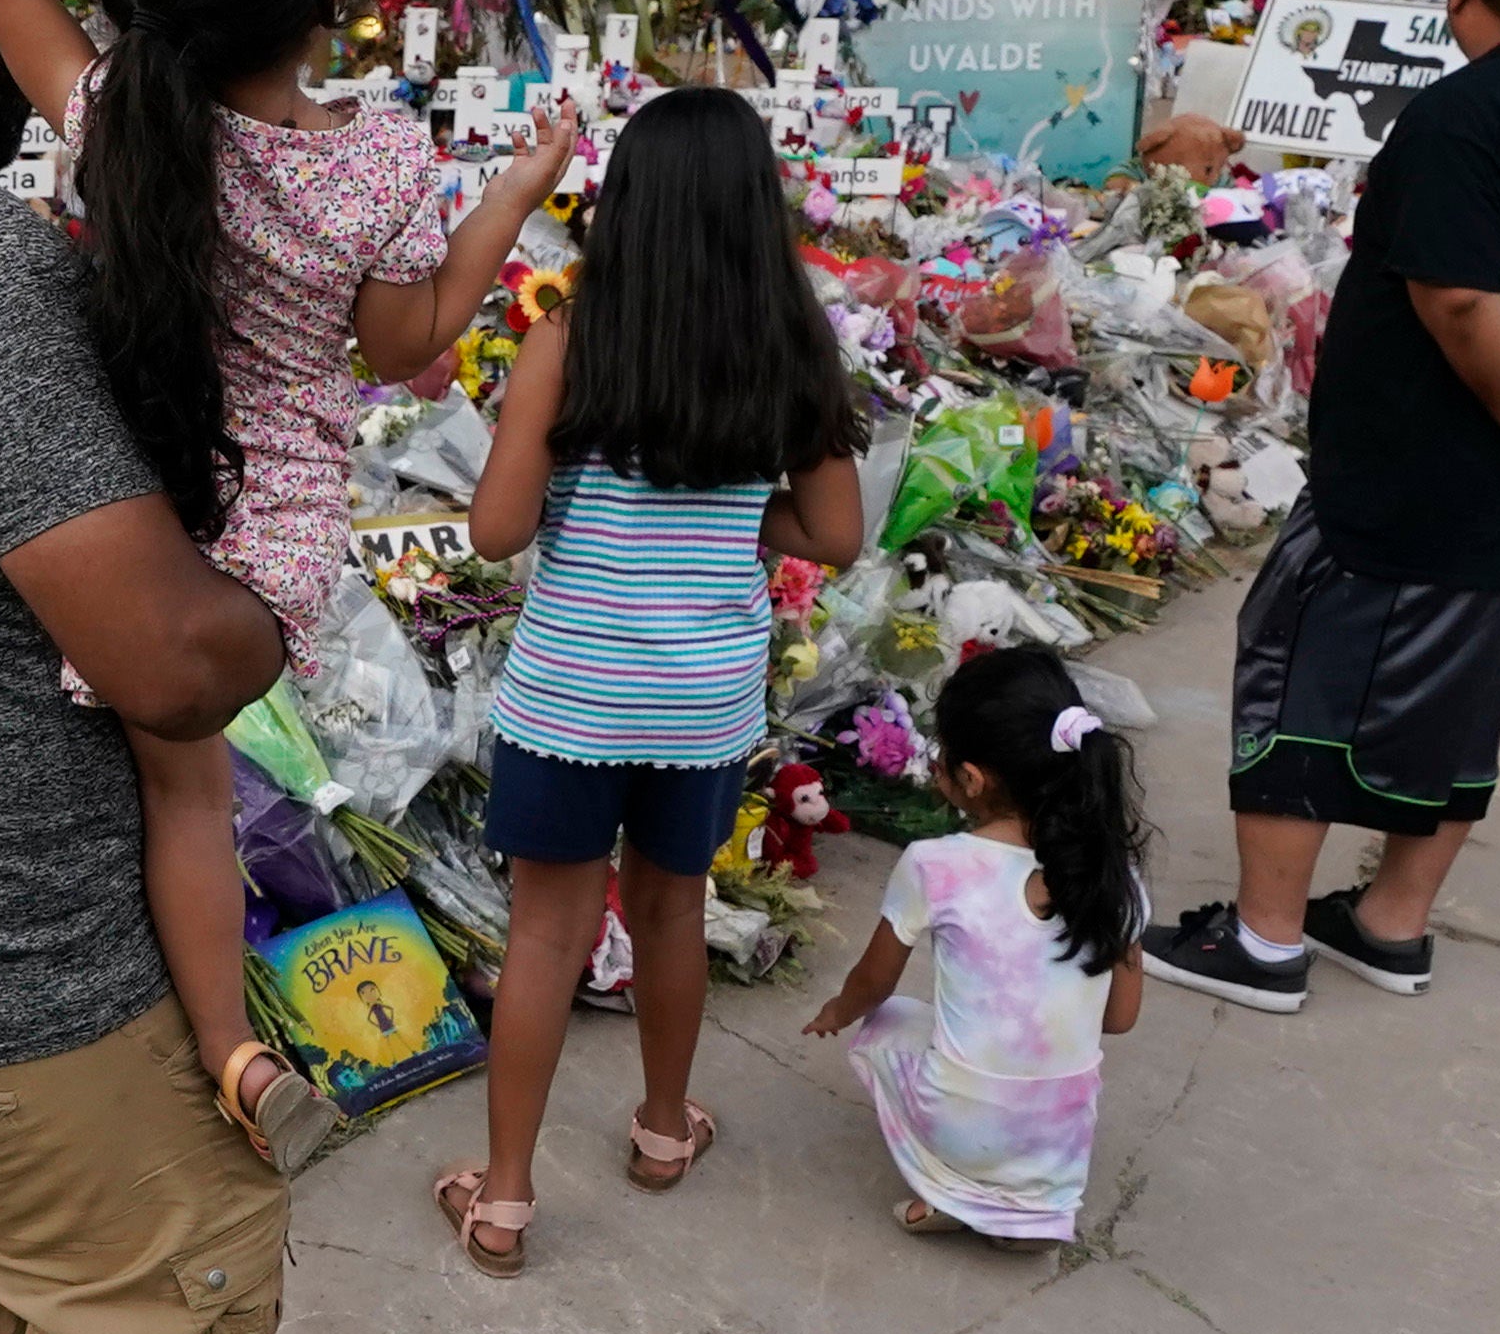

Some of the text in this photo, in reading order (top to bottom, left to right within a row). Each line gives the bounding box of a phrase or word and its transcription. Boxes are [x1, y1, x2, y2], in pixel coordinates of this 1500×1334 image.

[1405, 15, 1453, 46] SAN
[909, 41, 1045, 73] UVALDE
[1337, 59, 1398, 85] STANDS
[1240, 98, 1337, 141] UVALDE
[304, 920, 378, 958] When You Are
[301, 936, 403, 994] BRAVE
